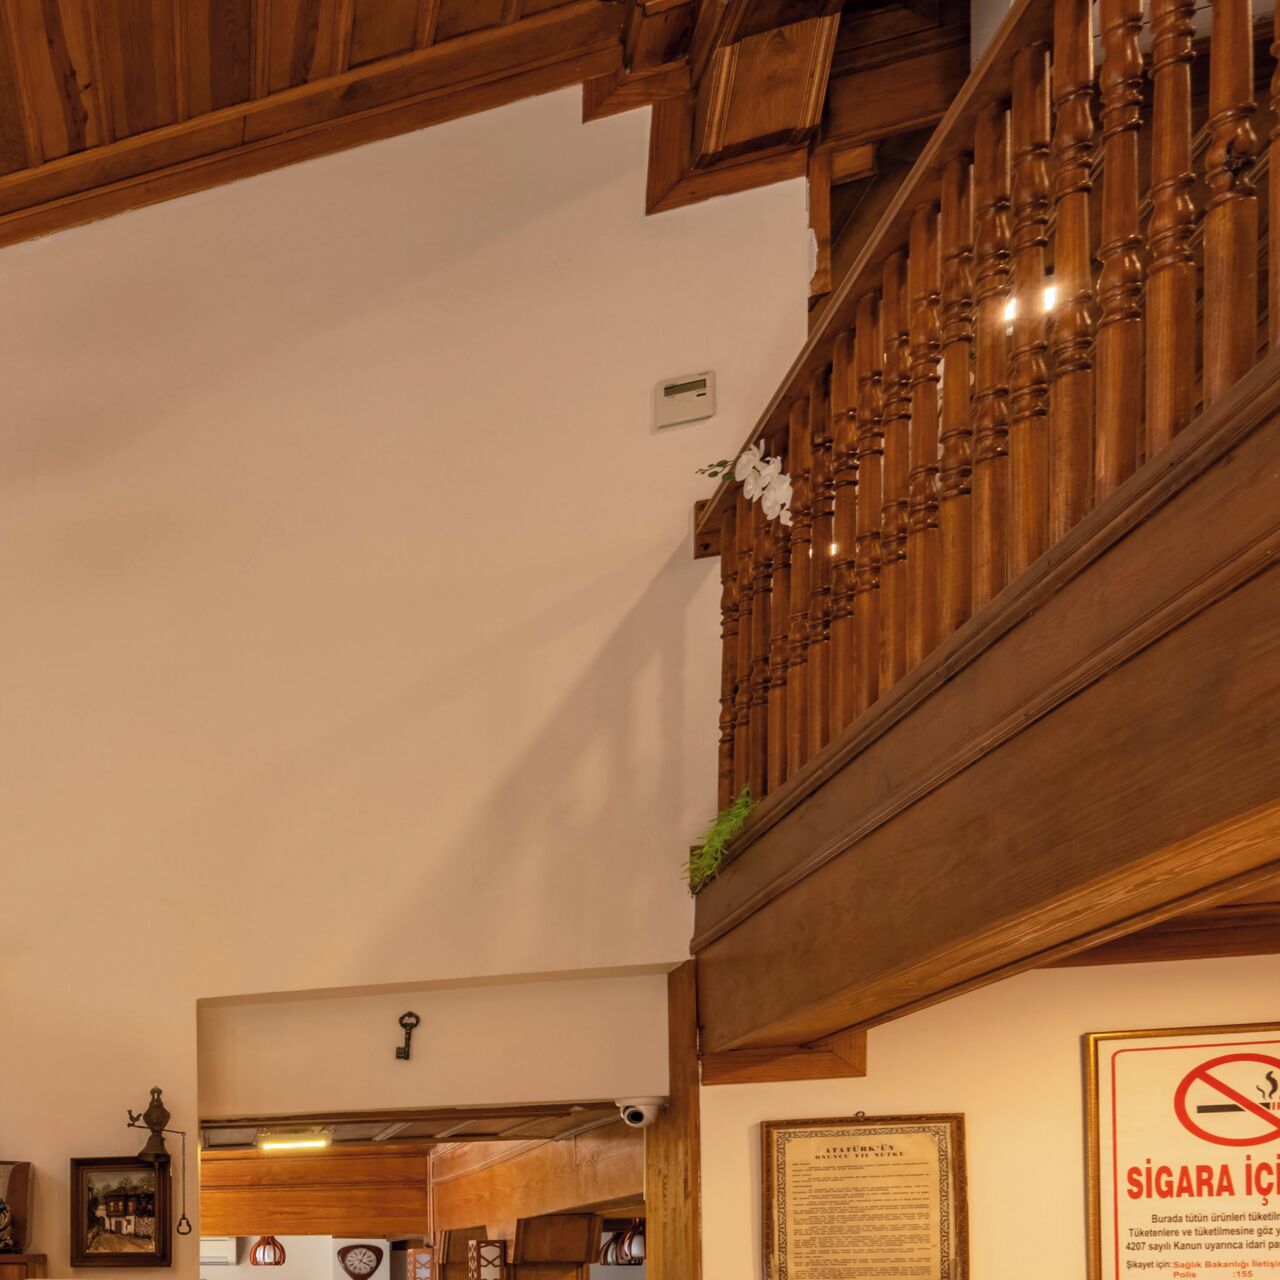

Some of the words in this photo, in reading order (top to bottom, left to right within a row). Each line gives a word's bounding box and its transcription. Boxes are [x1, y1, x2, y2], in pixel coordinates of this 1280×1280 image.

[1127, 1158, 1235, 1200] SİGARA
[1152, 1214, 1183, 1223] Burada
[1185, 1213, 1208, 1222] tütün
[1211, 1213, 1246, 1222] ürünleri
[1129, 1228, 1179, 1237] Tüketenlere
[1195, 1227, 1254, 1236] tüketilmesine
[1257, 1226, 1273, 1237] göz
[1126, 1242, 1146, 1251] 4207
[1148, 1242, 1171, 1252] sayılı
[1174, 1241, 1202, 1250] Kanun
[1204, 1241, 1243, 1251] uyarınca
[1246, 1240, 1266, 1249] idari
[1126, 1260, 1154, 1270] Şikayet
[1173, 1261, 1202, 1269] Sağlık
[1204, 1260, 1249, 1269] Bakanlığı
